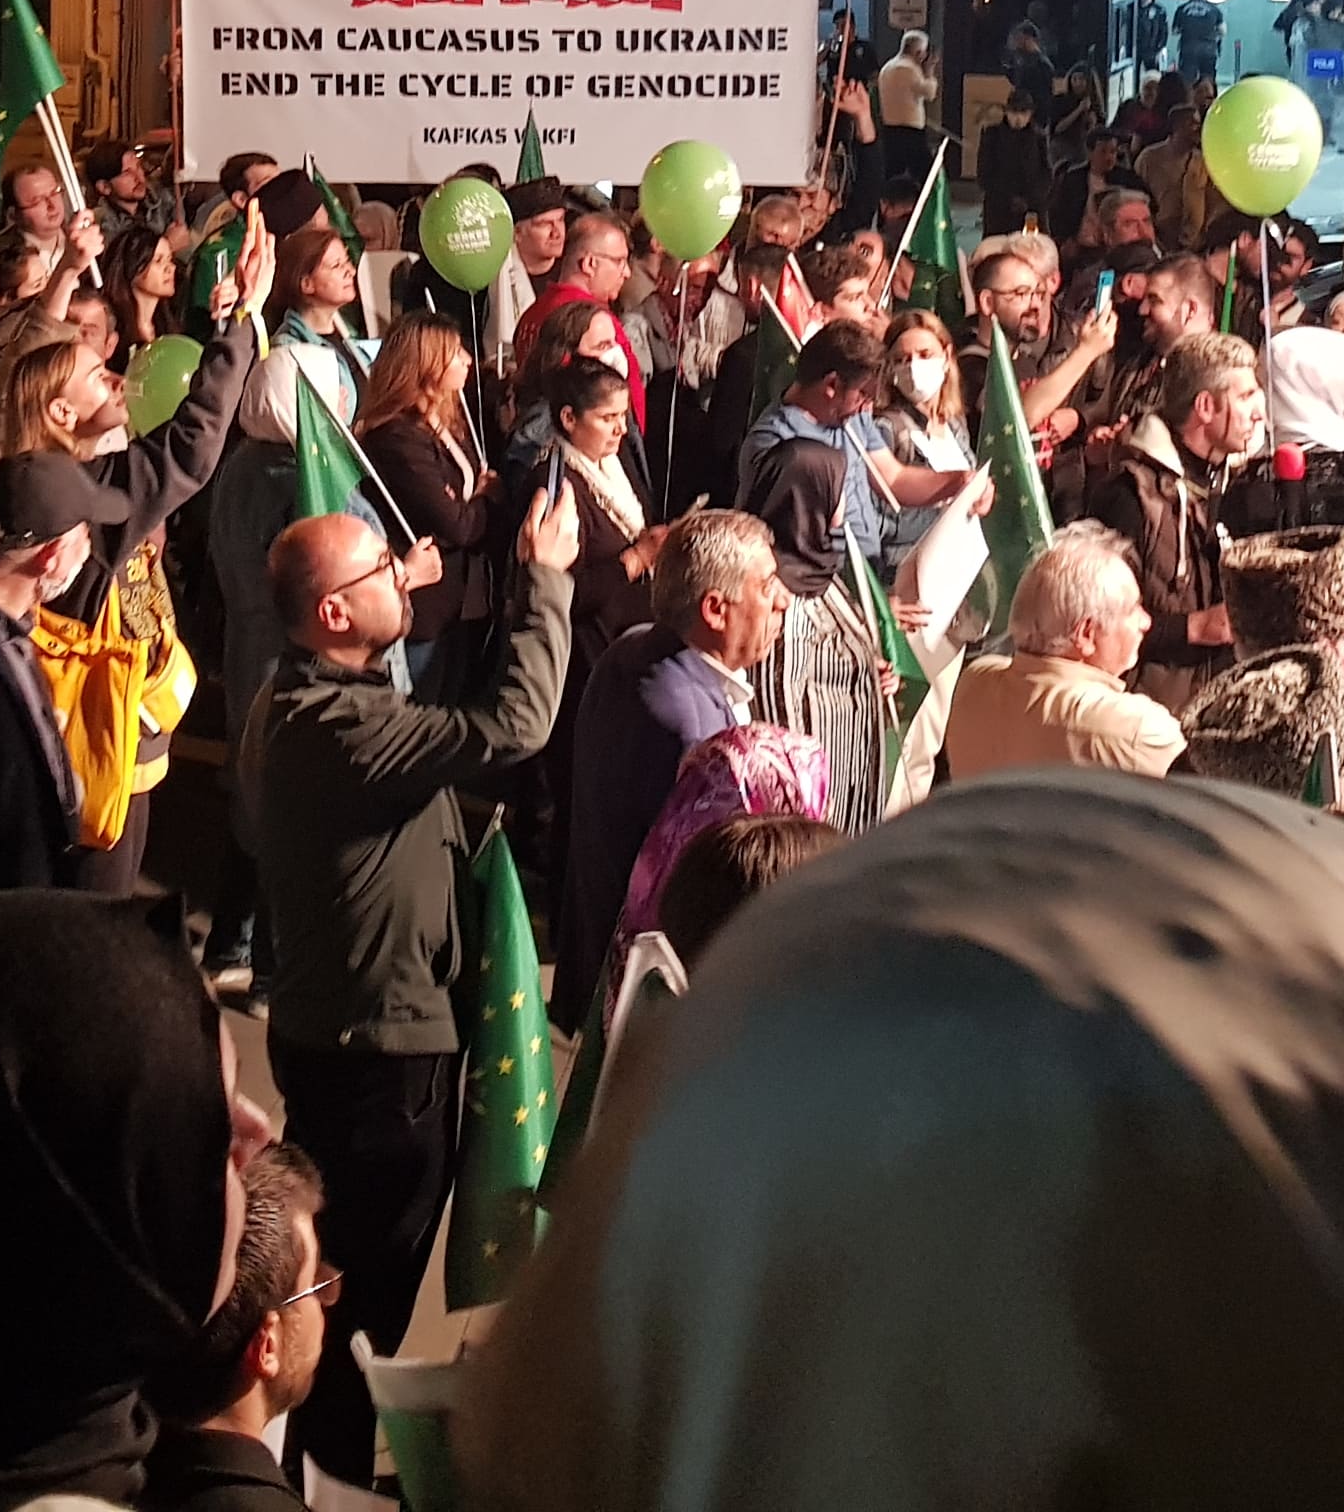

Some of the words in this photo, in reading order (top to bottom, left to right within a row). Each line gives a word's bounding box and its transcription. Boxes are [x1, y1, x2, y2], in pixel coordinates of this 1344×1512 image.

[212, 26, 324, 53] FROM
[336, 27, 540, 54] CAUCASUS
[551, 28, 602, 54] TO
[615, 27, 789, 54] UKRAINE
[221, 72, 299, 98] END
[310, 72, 385, 98] THE
[398, 73, 513, 99] CYCLE
[525, 74, 575, 99] OF
[587, 74, 781, 99] GENOCIDE
[423, 127, 507, 145] KAFKAS
[513, 127, 576, 145] VKFI
